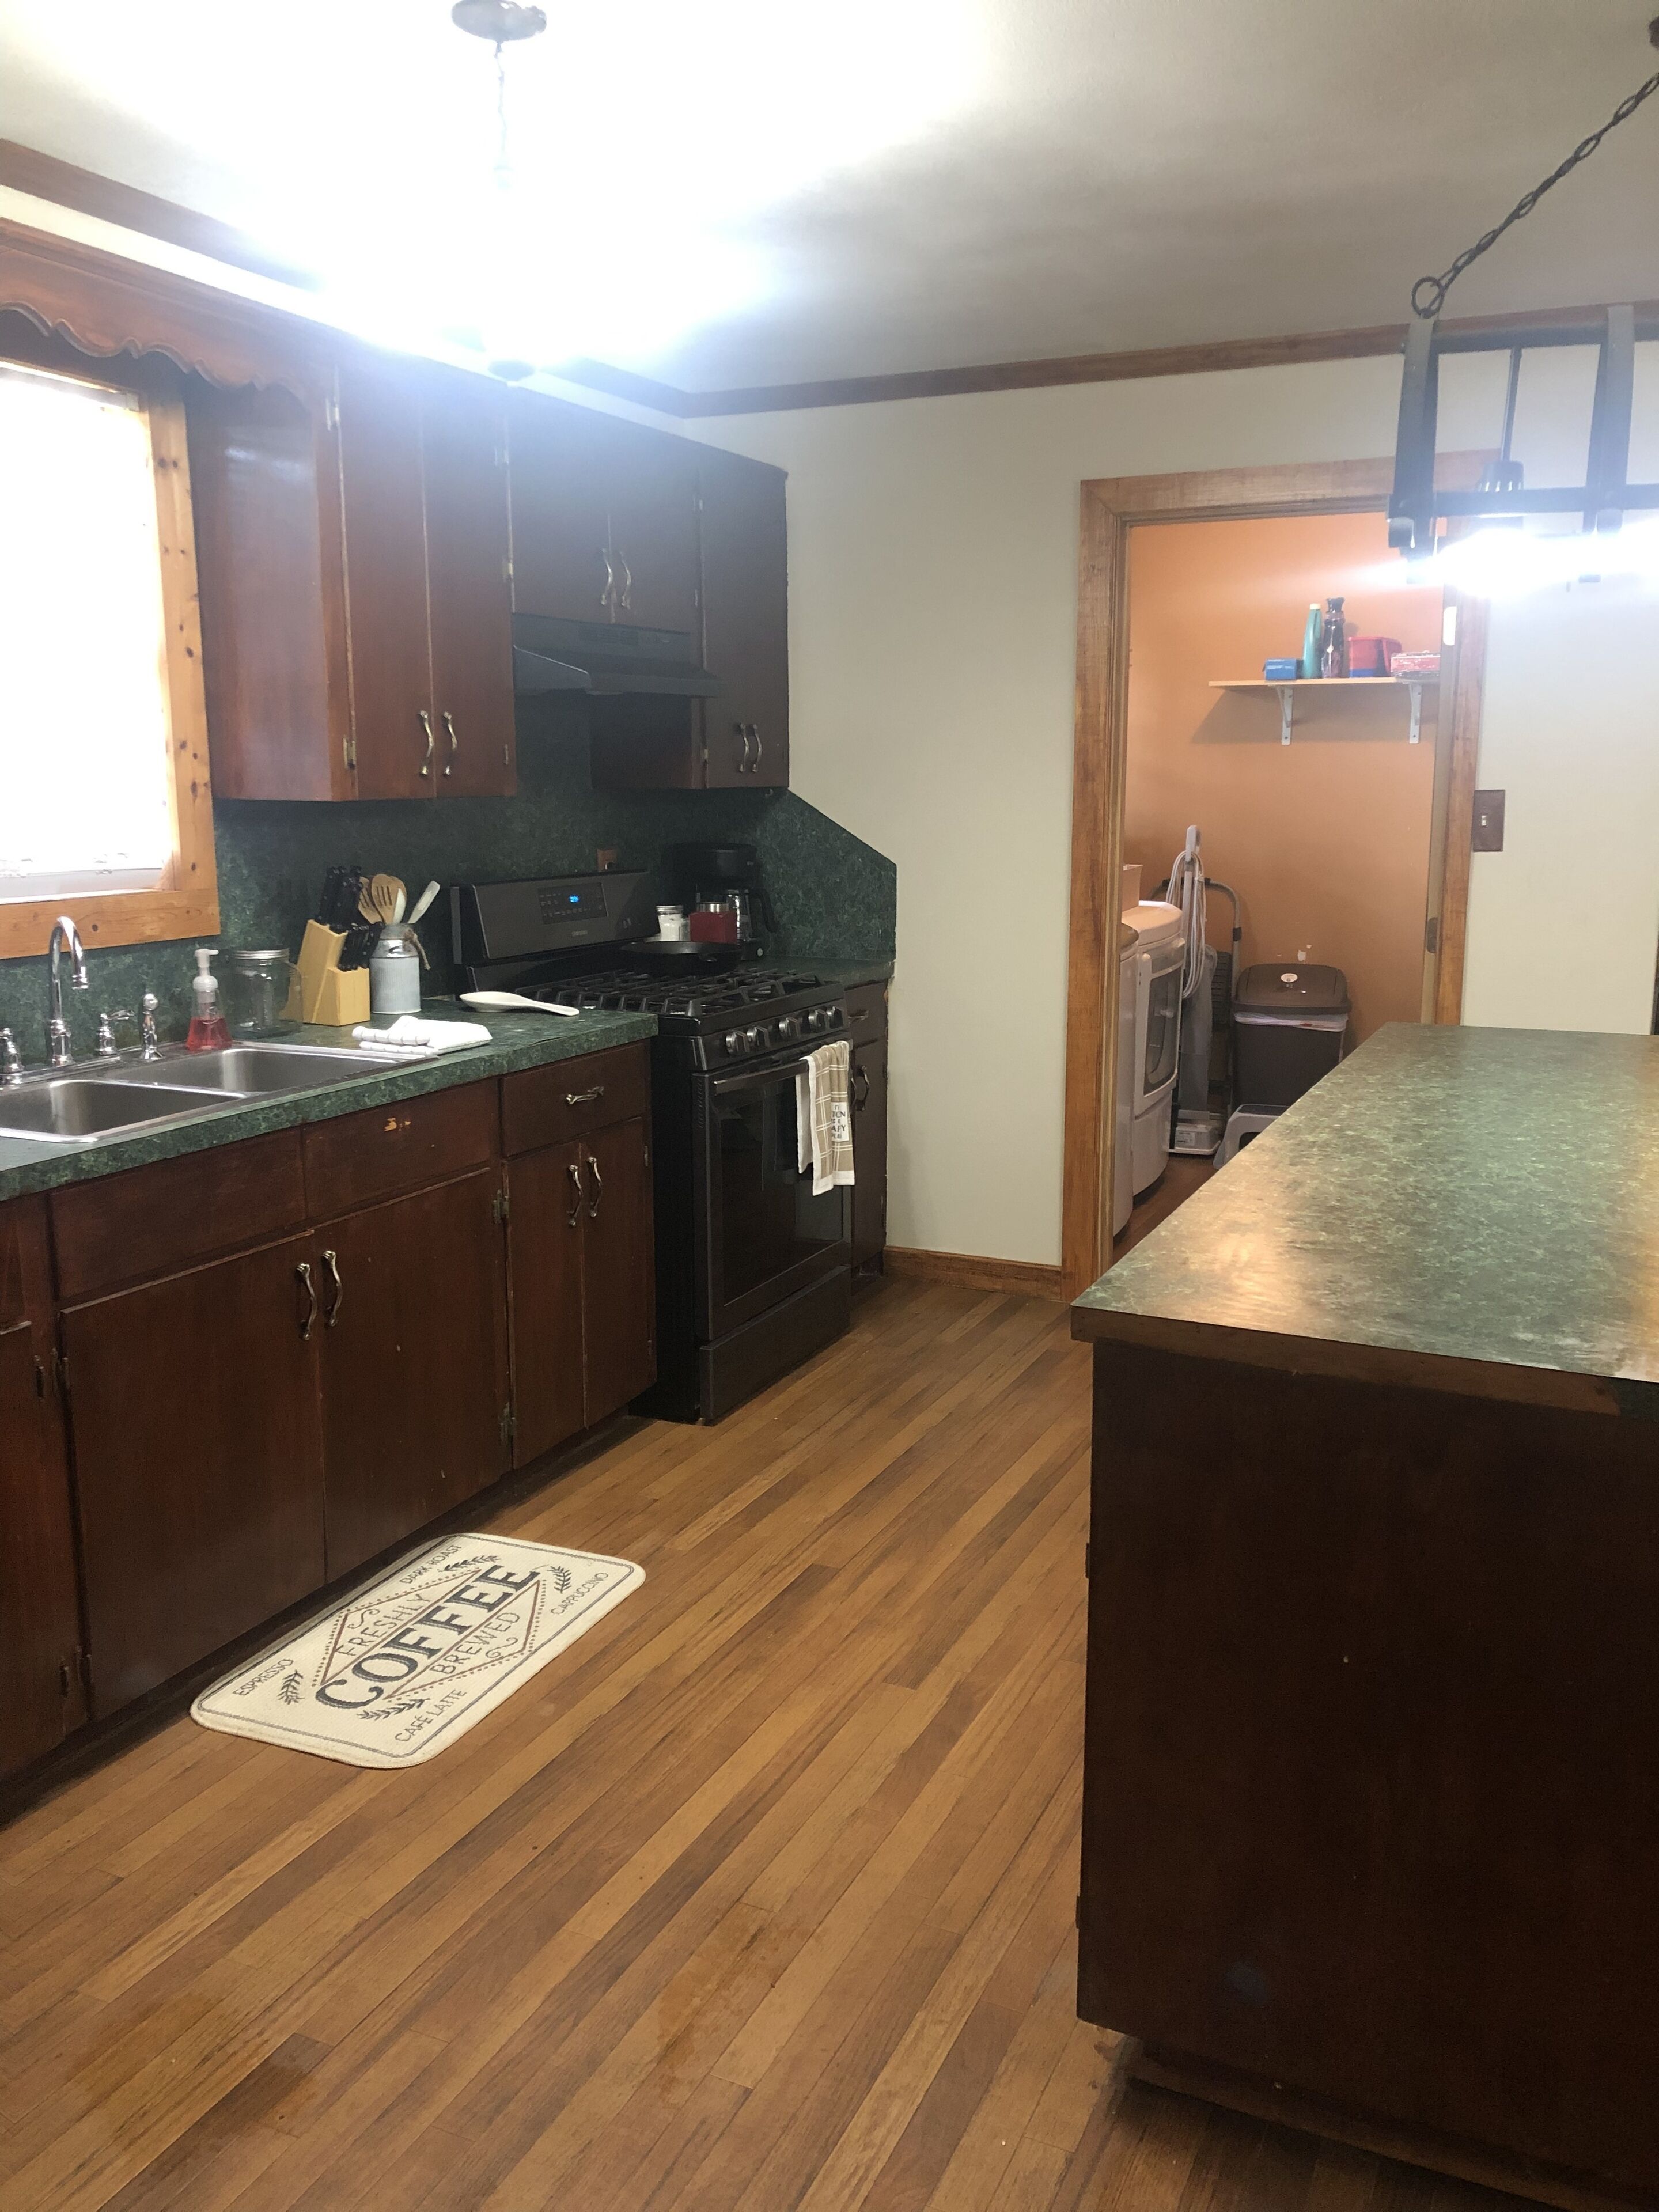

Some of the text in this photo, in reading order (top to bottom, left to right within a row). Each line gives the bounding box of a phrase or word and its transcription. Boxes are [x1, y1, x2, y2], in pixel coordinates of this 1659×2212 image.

[399, 1544, 462, 1584] DARK ROAST
[551, 1573, 608, 1615] CAPPUCCINO
[315, 1565, 540, 1709] COFFEE
[334, 1594, 430, 1657] FRESHLY
[430, 1612, 520, 1674] BREWED
[233, 1659, 294, 1695] ESPRESSO
[426, 1689, 467, 1716] LATTE
